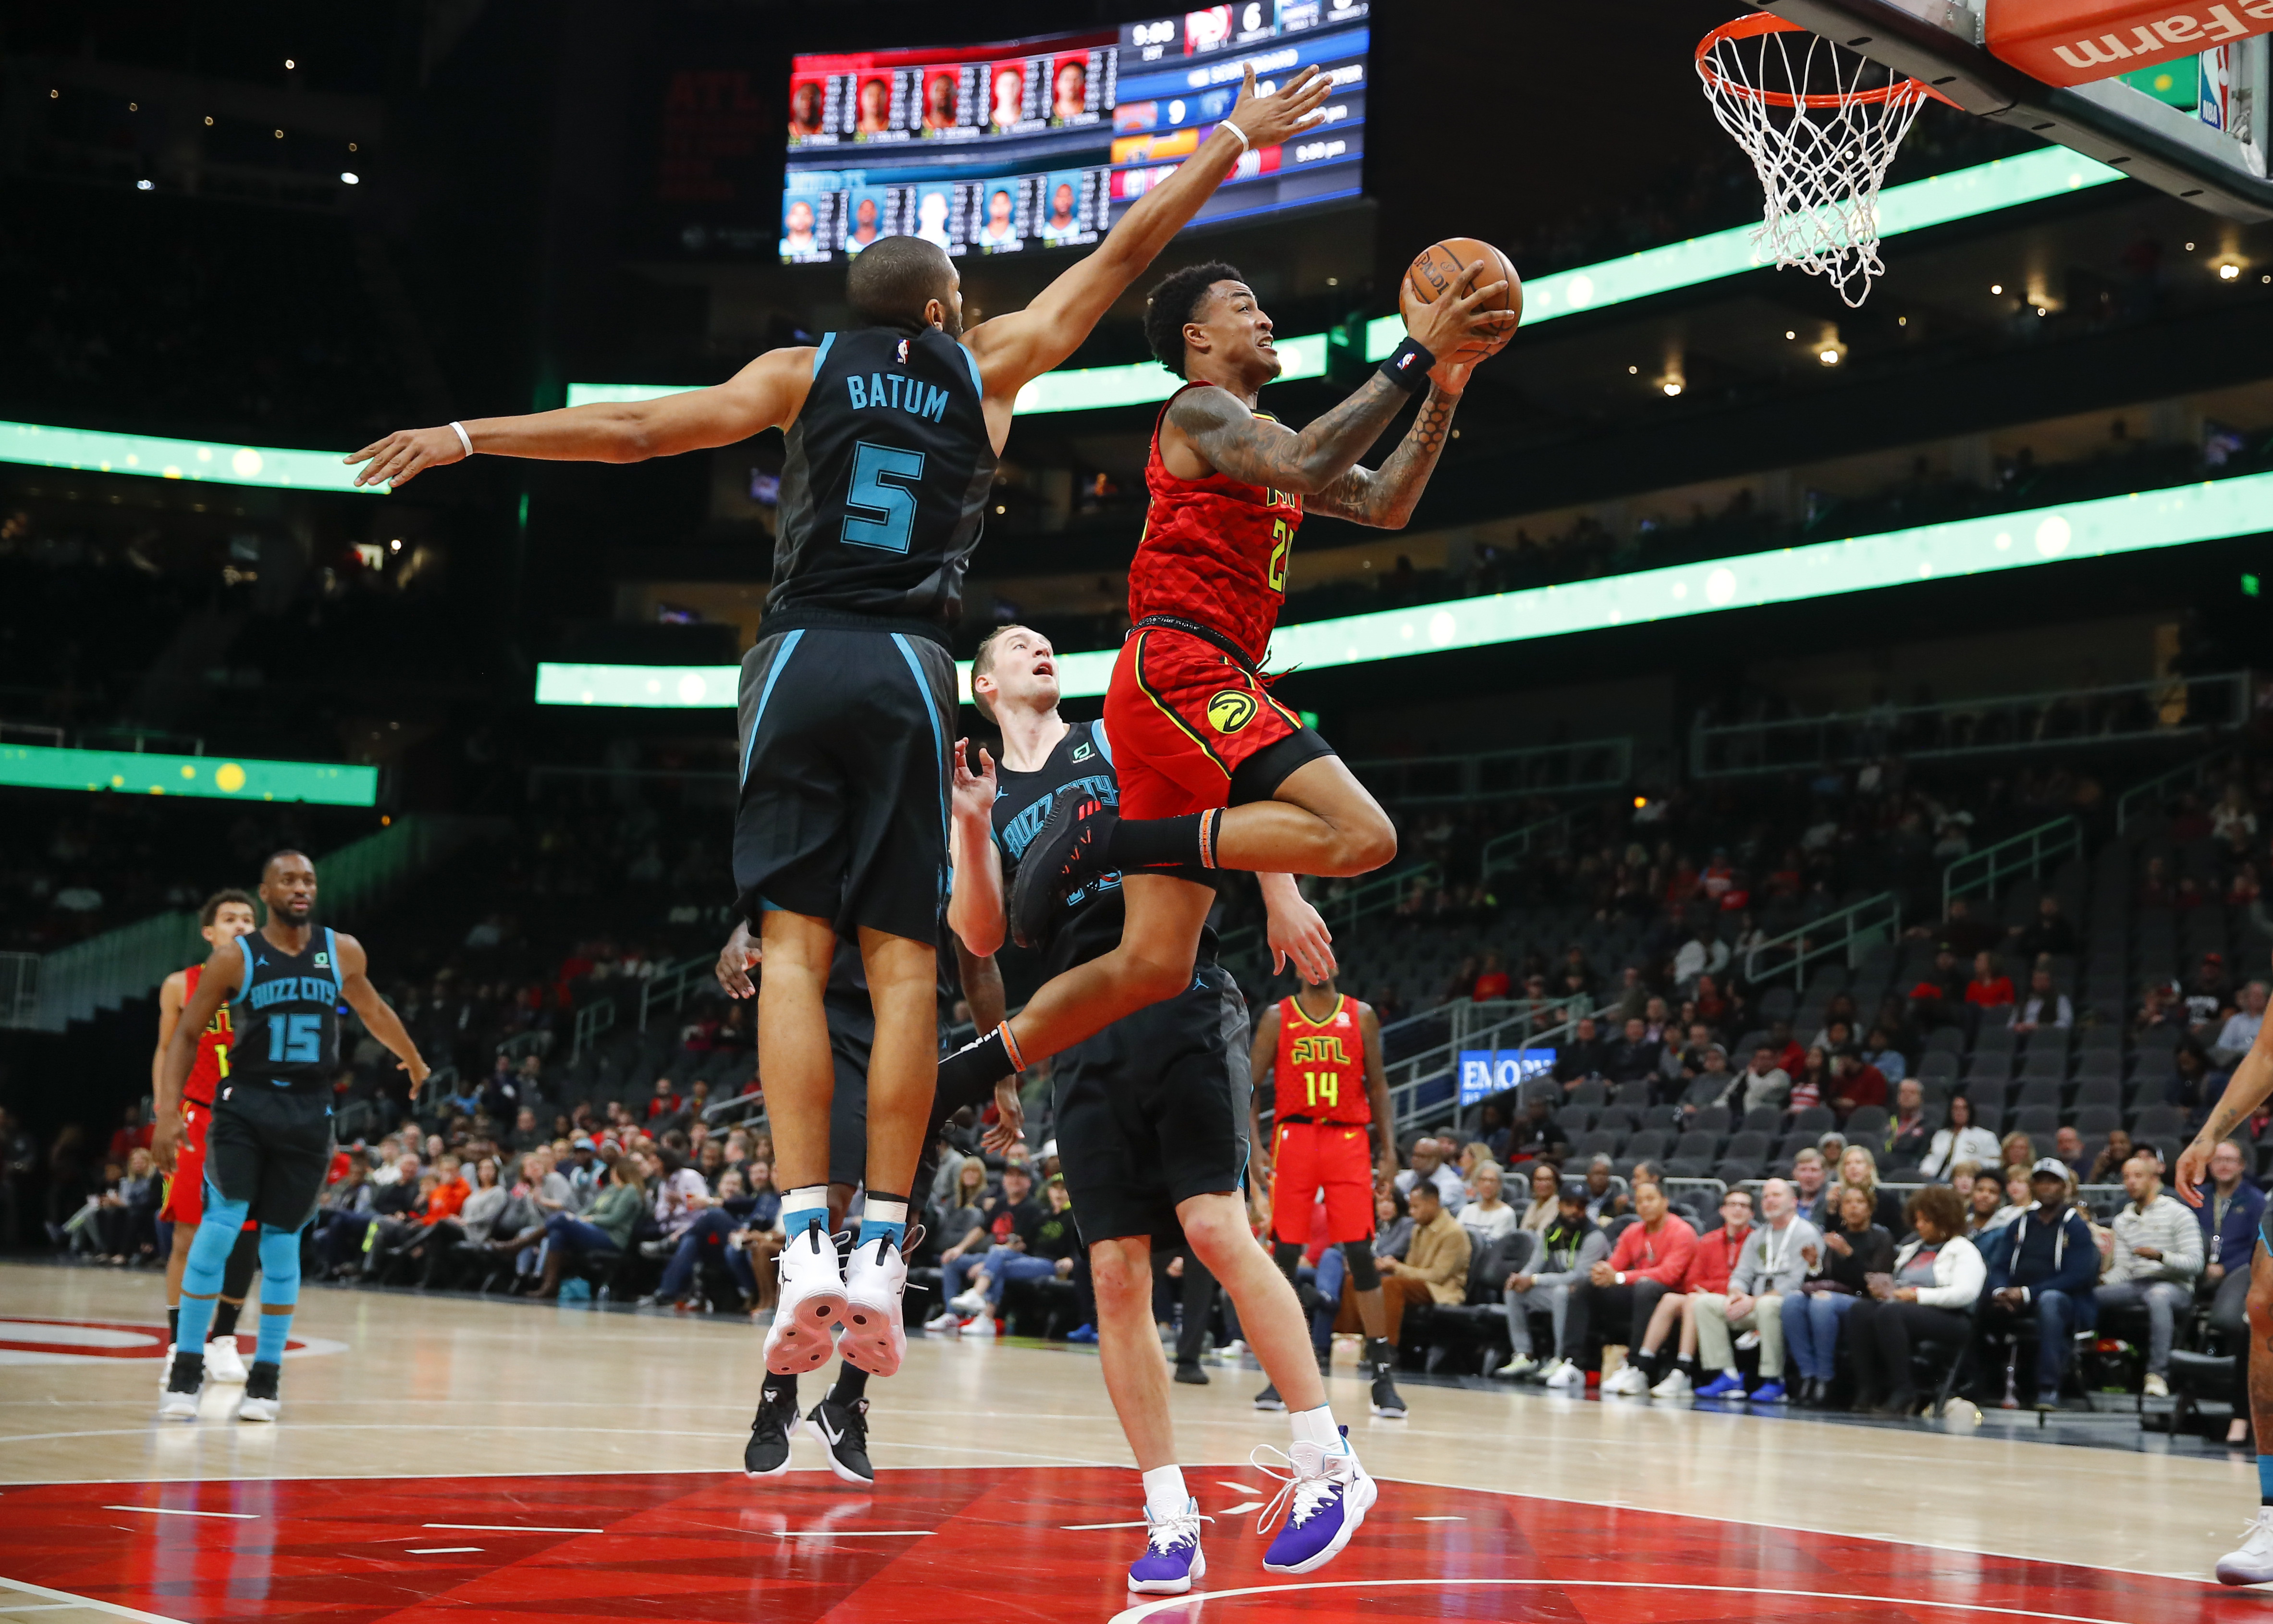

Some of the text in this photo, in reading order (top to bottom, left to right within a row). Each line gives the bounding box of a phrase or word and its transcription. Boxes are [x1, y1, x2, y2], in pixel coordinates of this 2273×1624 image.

[1242, 2, 1261, 32] 6
[2052, 4, 2249, 68] Farm
[1168, 99, 1186, 124] 9
[2203, 99, 2218, 124] NBA
[847, 372, 949, 423] BATUM
[840, 441, 925, 554] 5
[1268, 517, 1294, 593] 2
[1002, 793, 1054, 862] BUZZ
[250, 976, 336, 1010] BUZZ CITY
[268, 1013, 321, 1062] 15
[1291, 1036, 1351, 1065] ATL
[1303, 1071, 1339, 1107] 14
